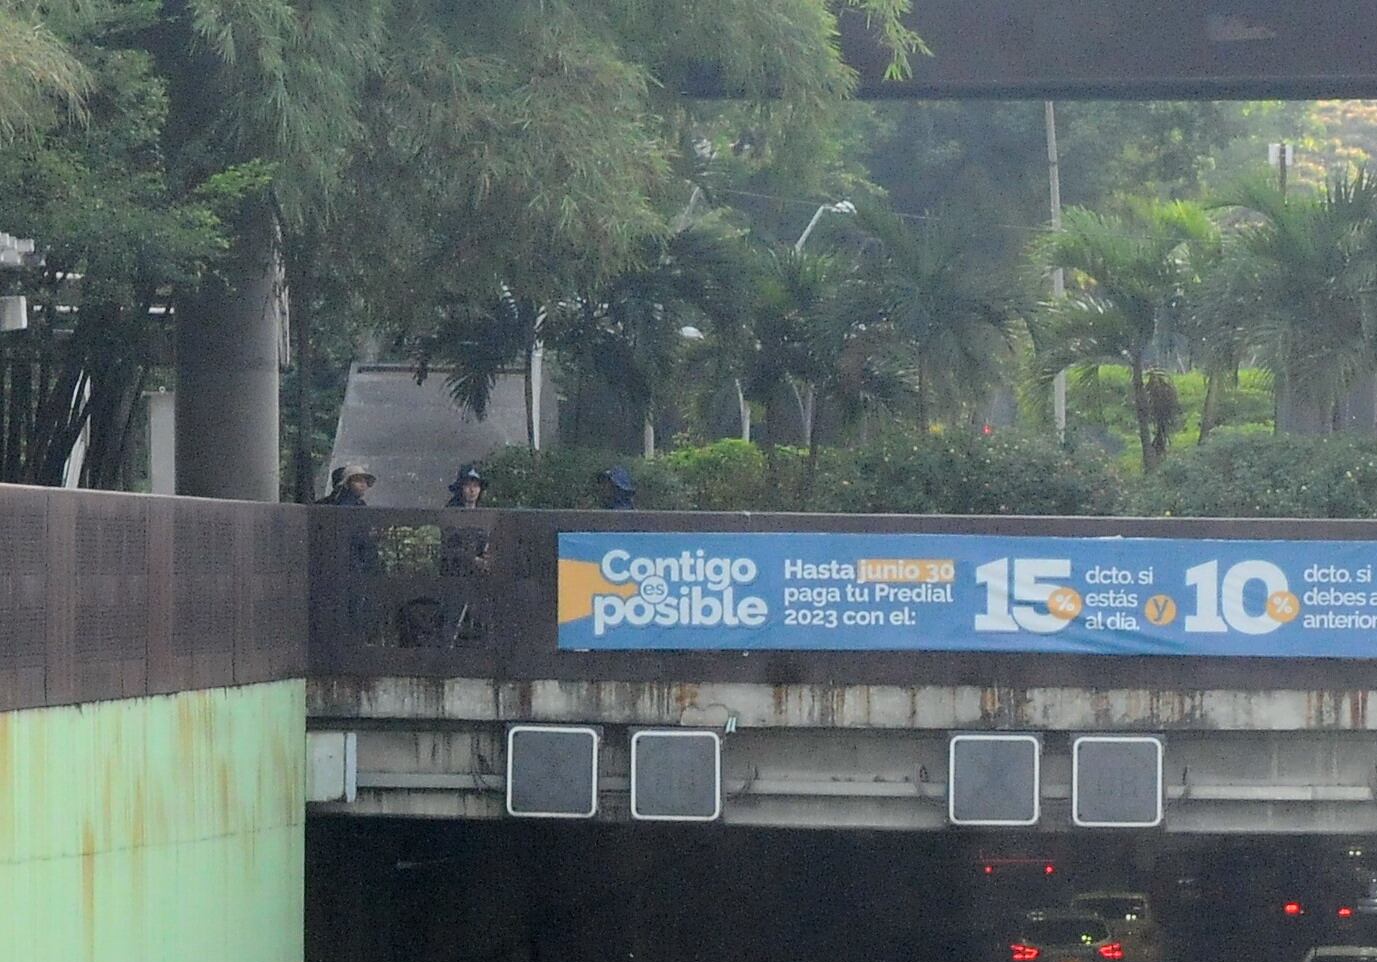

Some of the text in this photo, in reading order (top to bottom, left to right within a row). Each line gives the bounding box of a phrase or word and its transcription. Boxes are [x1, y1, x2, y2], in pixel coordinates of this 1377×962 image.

[601, 549, 758, 591] Contigo
[783, 559, 955, 584] Hasta junio 30
[1085, 565, 1154, 585] dcto. si
[1303, 564, 1372, 583] dcto. si
[642, 583, 664, 596] es
[783, 583, 954, 607] paga tu Predial
[1085, 589, 1139, 608] estás
[1303, 587, 1367, 606] debes
[593, 585, 768, 636] posible
[783, 606, 917, 628] 2023 con el:
[1085, 611, 1103, 630] al
[1151, 598, 1169, 622] y
